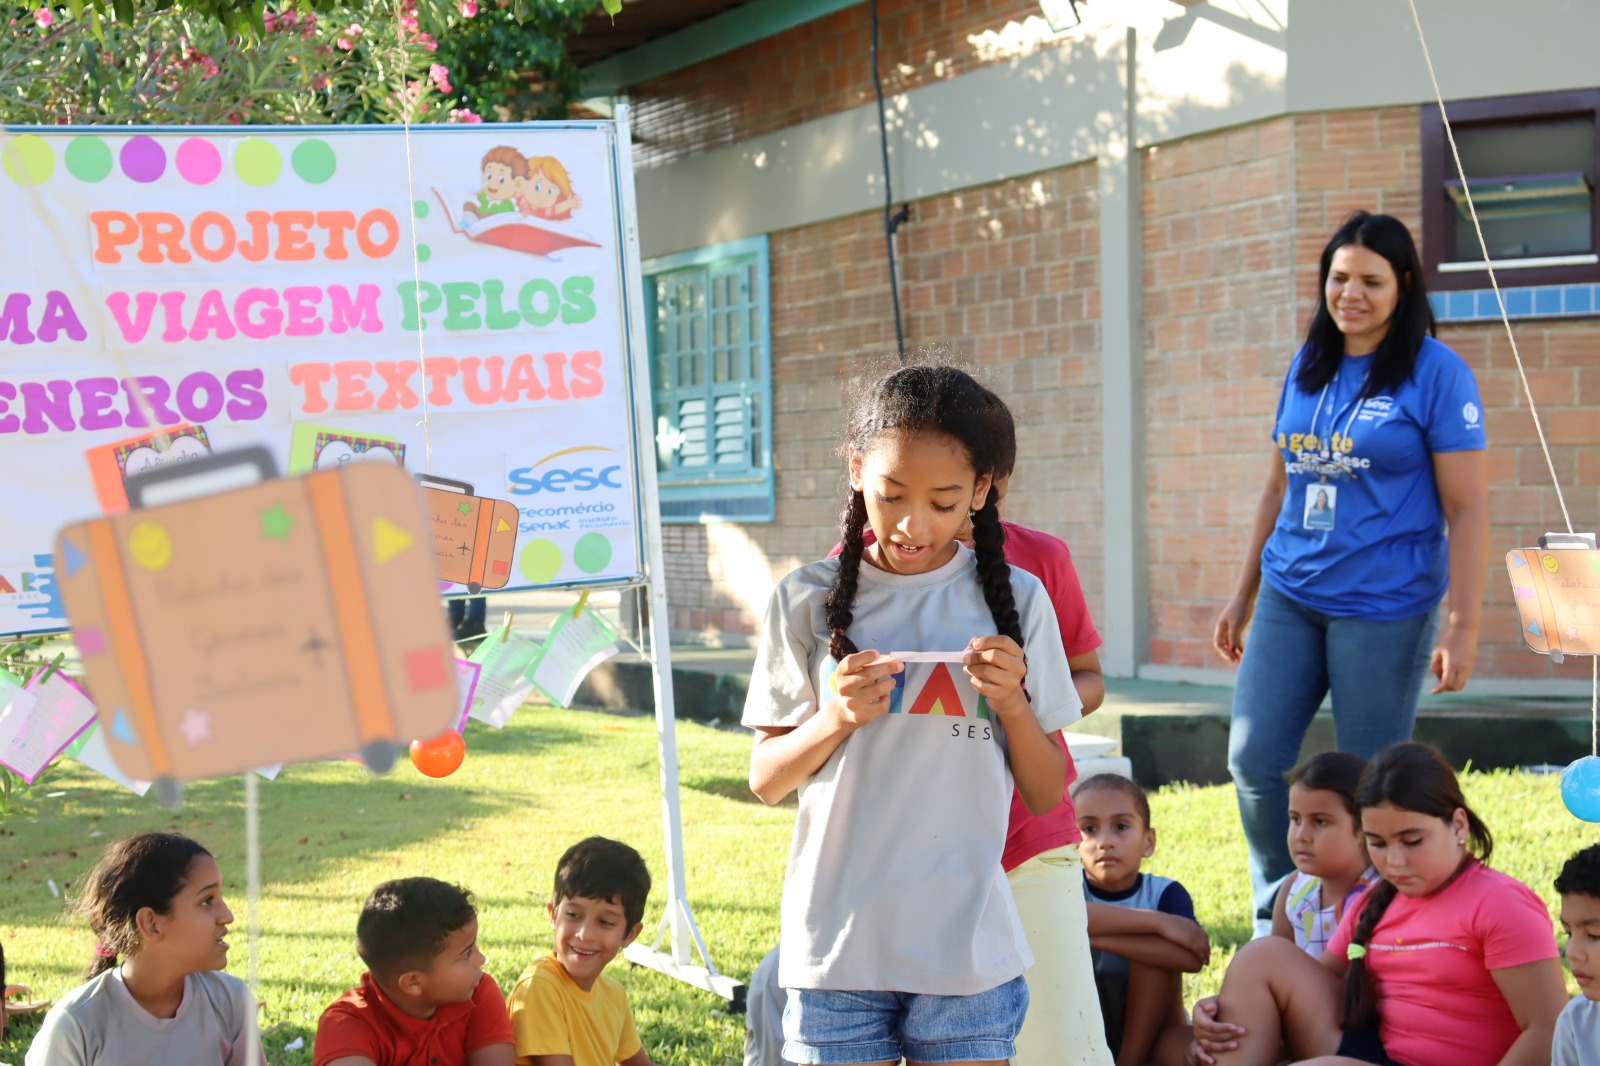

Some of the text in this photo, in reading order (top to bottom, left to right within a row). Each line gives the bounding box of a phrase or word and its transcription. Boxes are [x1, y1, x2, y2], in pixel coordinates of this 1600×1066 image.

[105, 284, 384, 344] VIAGEM
[395, 276, 597, 332] PELOS
[289, 350, 604, 414] TEXTUAIS
